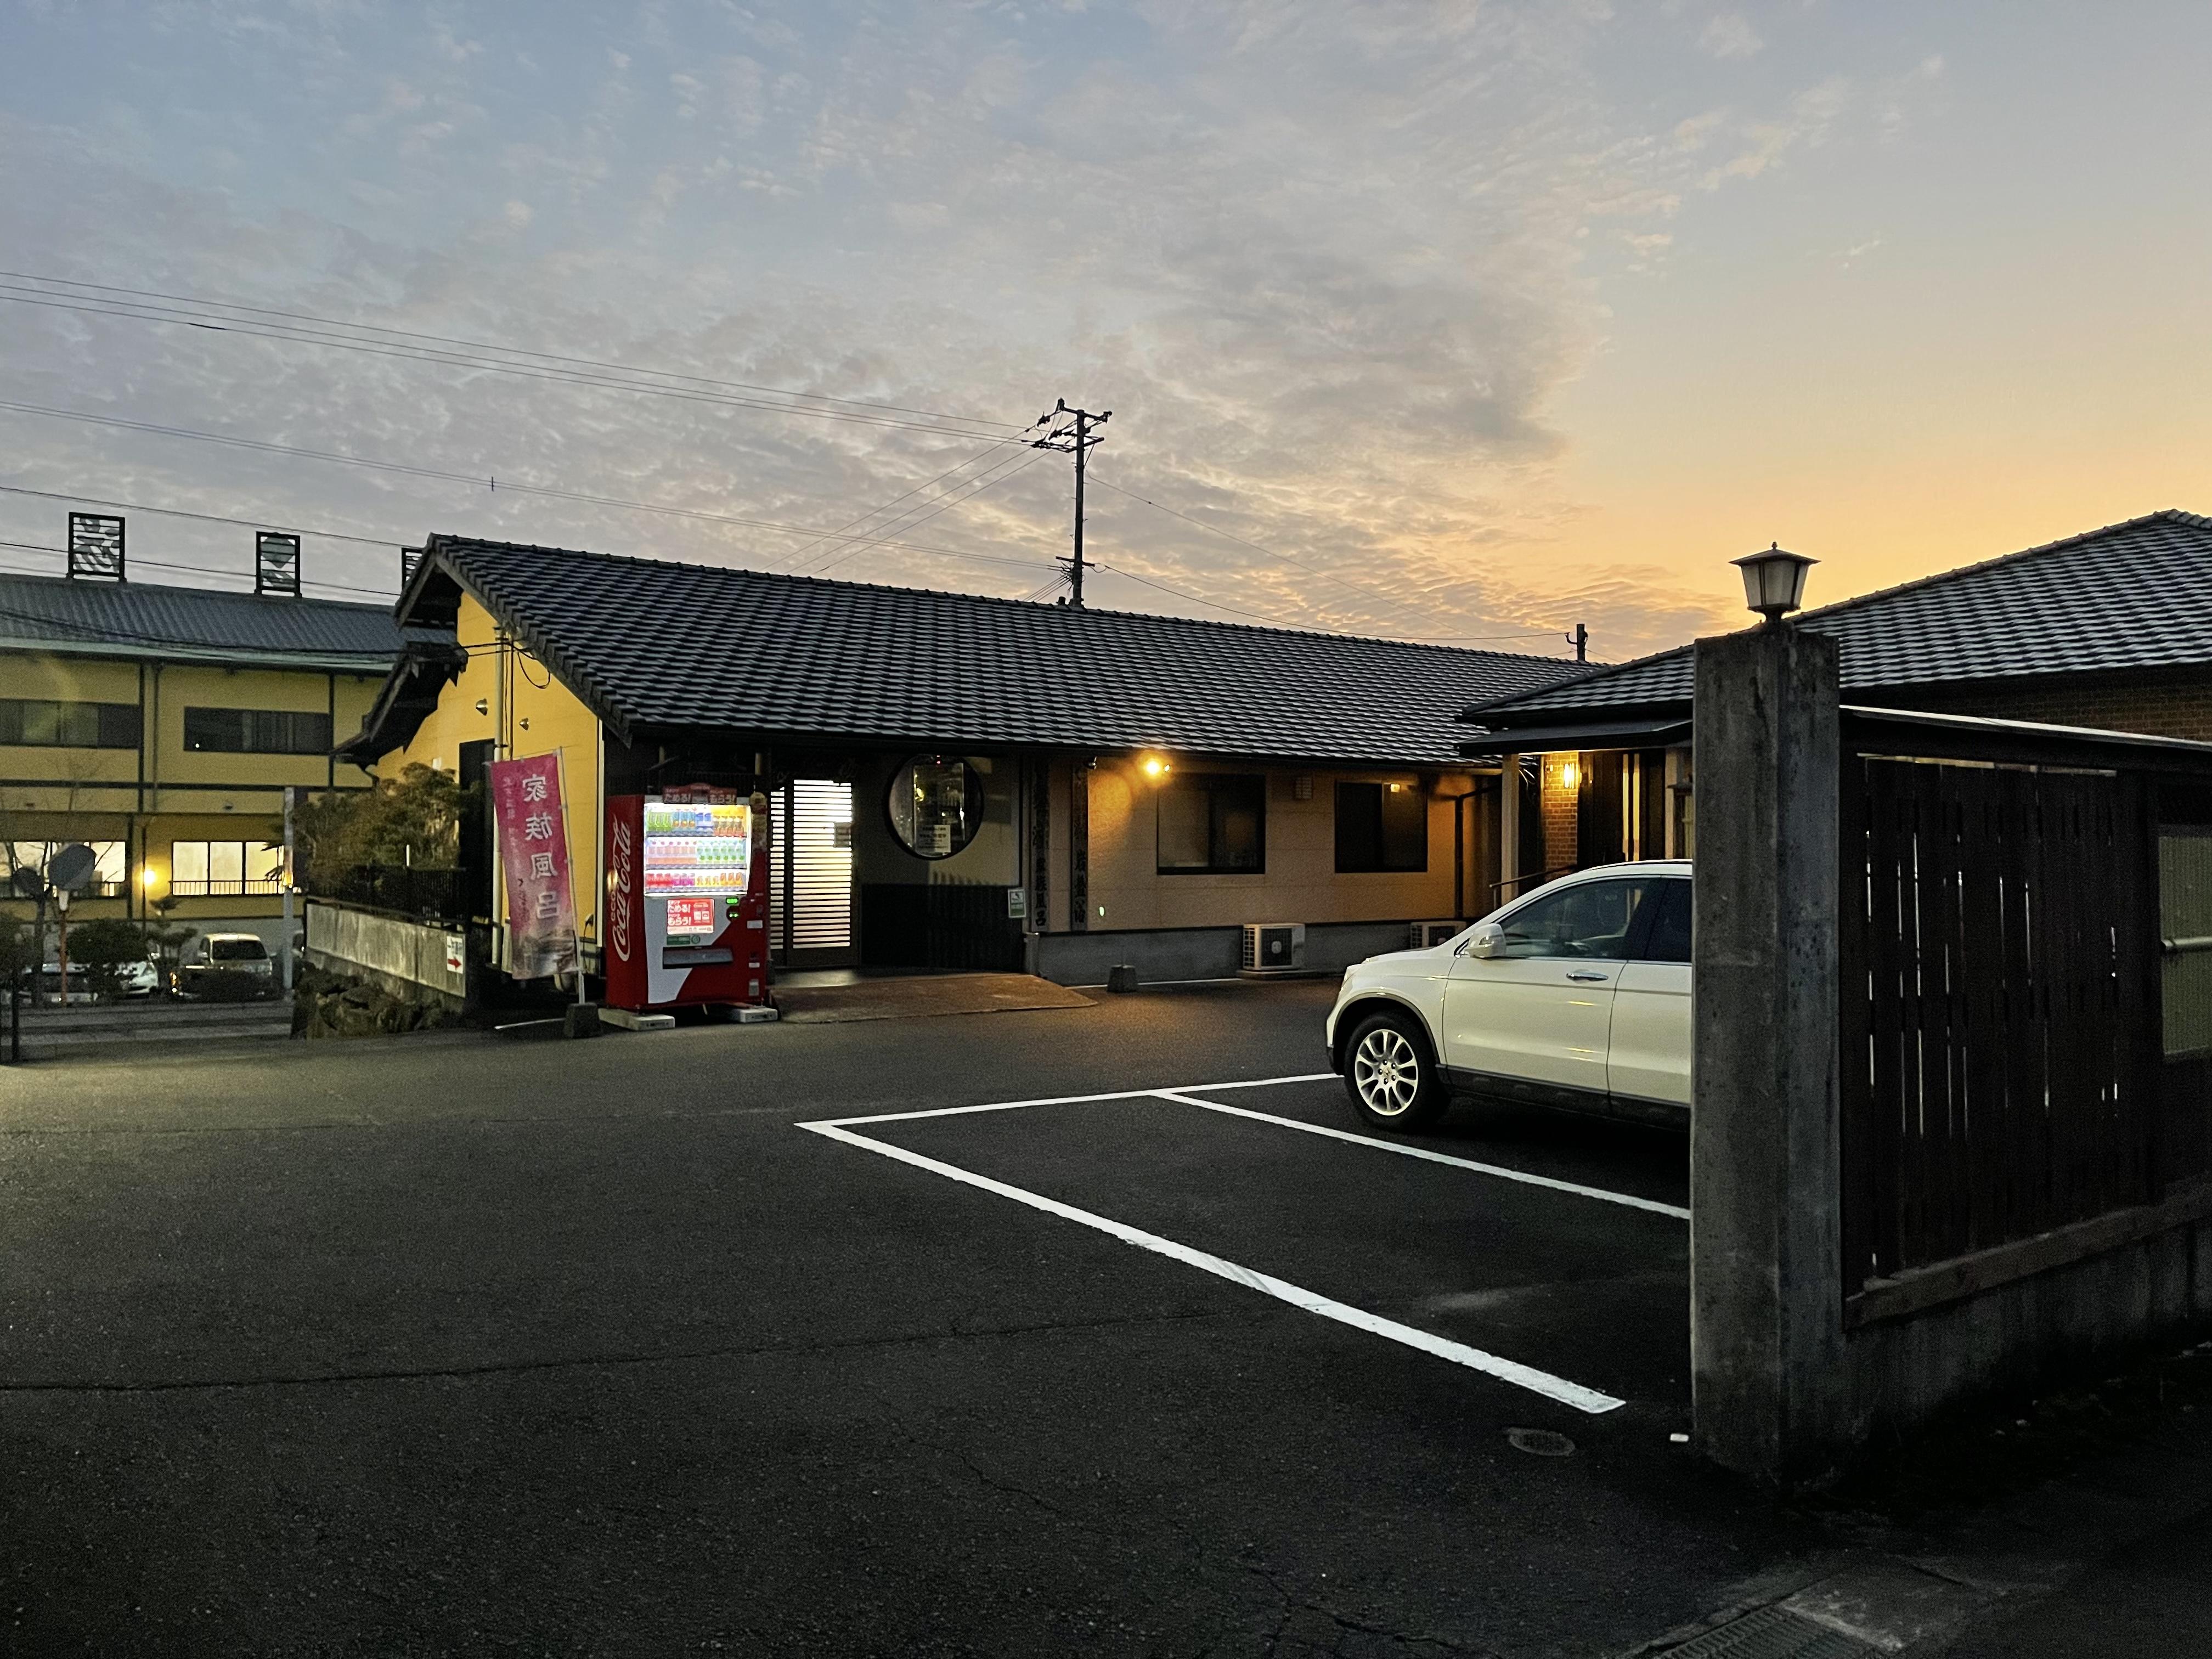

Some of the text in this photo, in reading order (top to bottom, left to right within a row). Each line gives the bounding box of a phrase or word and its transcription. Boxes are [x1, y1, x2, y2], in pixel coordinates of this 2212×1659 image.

[612, 813, 630, 961] Coca-Cola
[1035, 857, 1047, 927] 家族風呂
